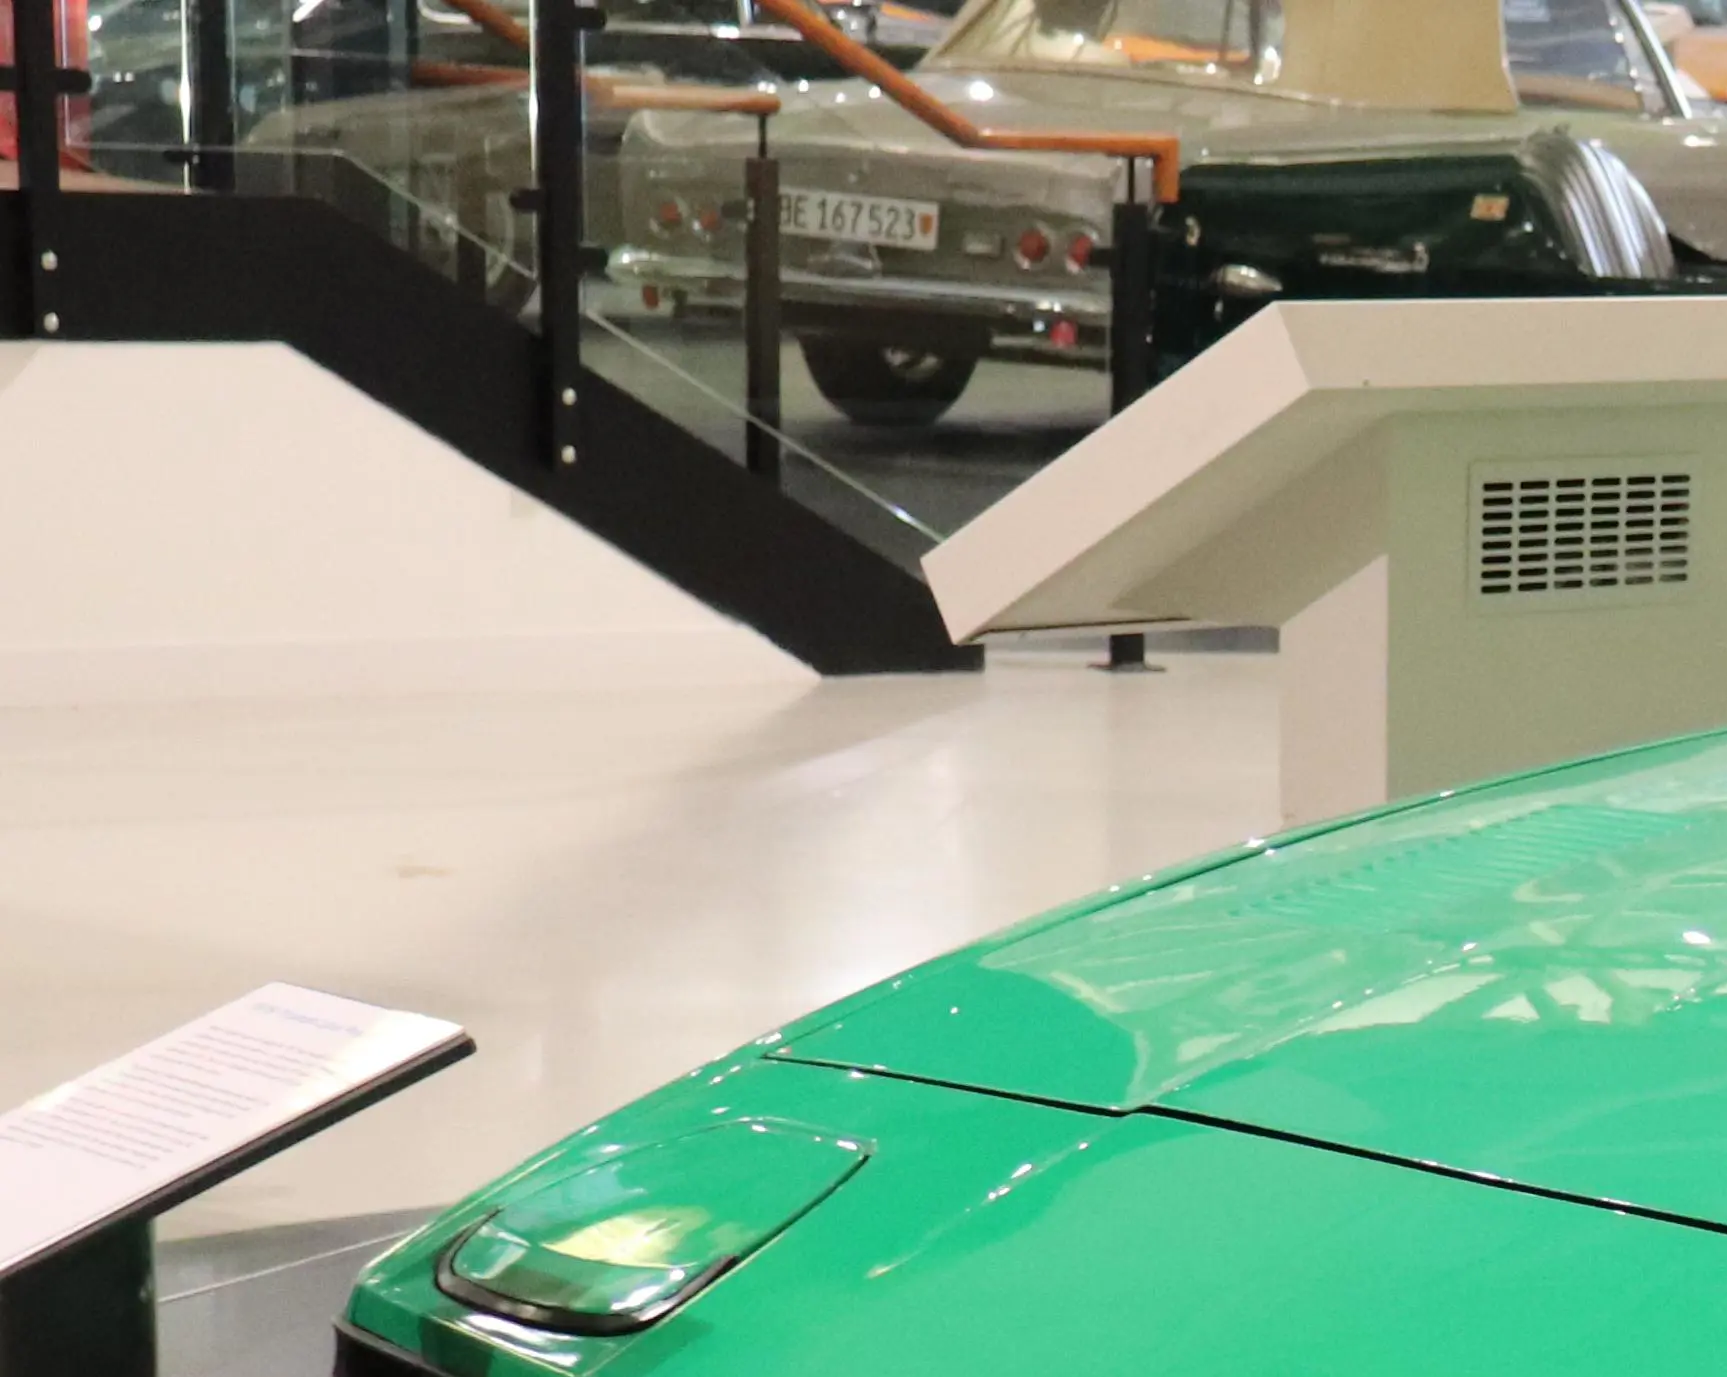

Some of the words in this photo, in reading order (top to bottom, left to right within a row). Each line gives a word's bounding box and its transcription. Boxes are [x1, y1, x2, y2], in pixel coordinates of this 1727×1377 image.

[779, 194, 806, 228] BE
[817, 198, 863, 233] 167
[868, 204, 915, 241] 523
